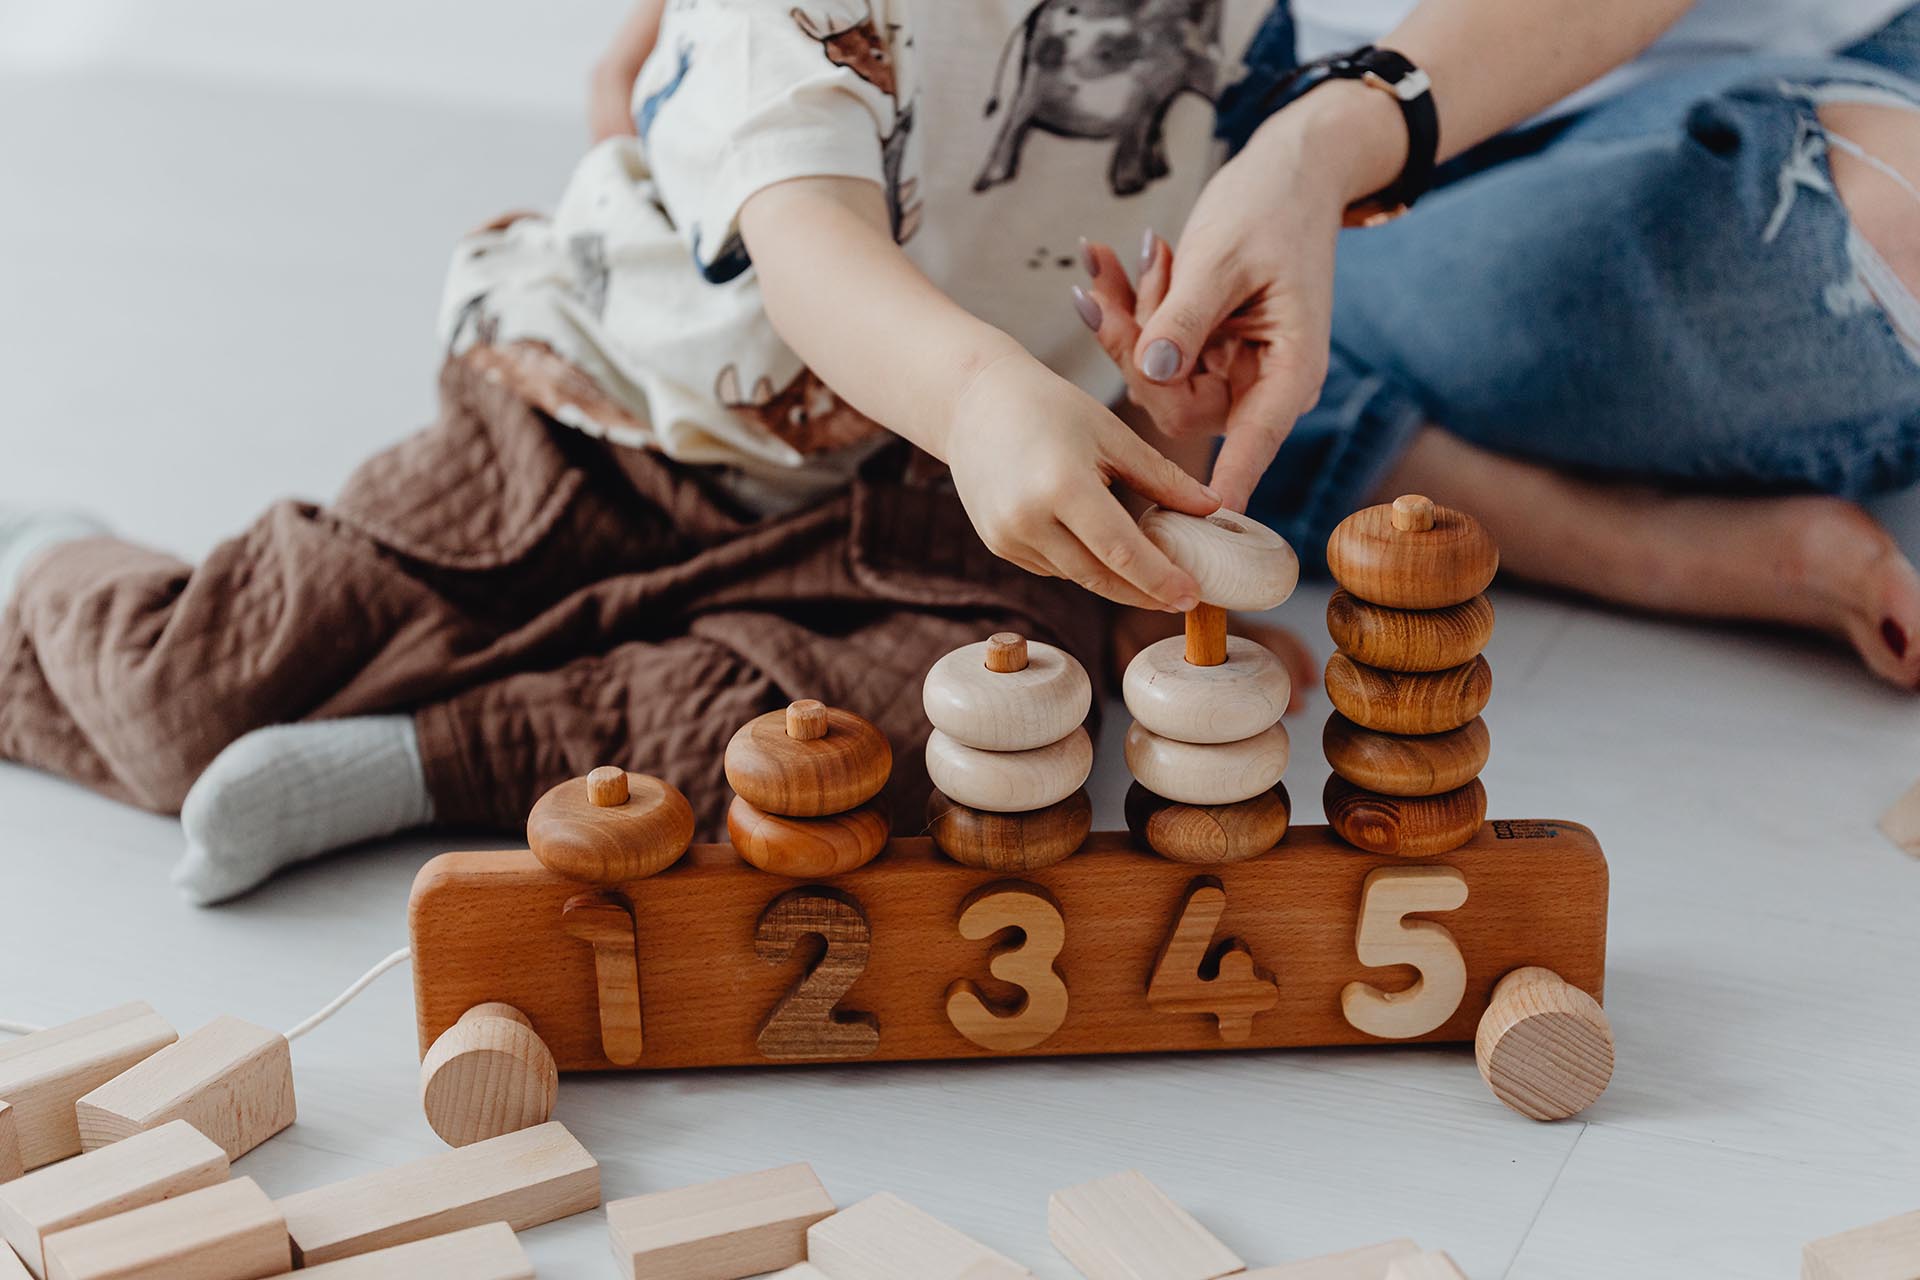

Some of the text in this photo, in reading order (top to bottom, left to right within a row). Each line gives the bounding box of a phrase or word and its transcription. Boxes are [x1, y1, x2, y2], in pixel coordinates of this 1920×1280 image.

[562, 866, 1469, 1065] 1 2 3 4 5
